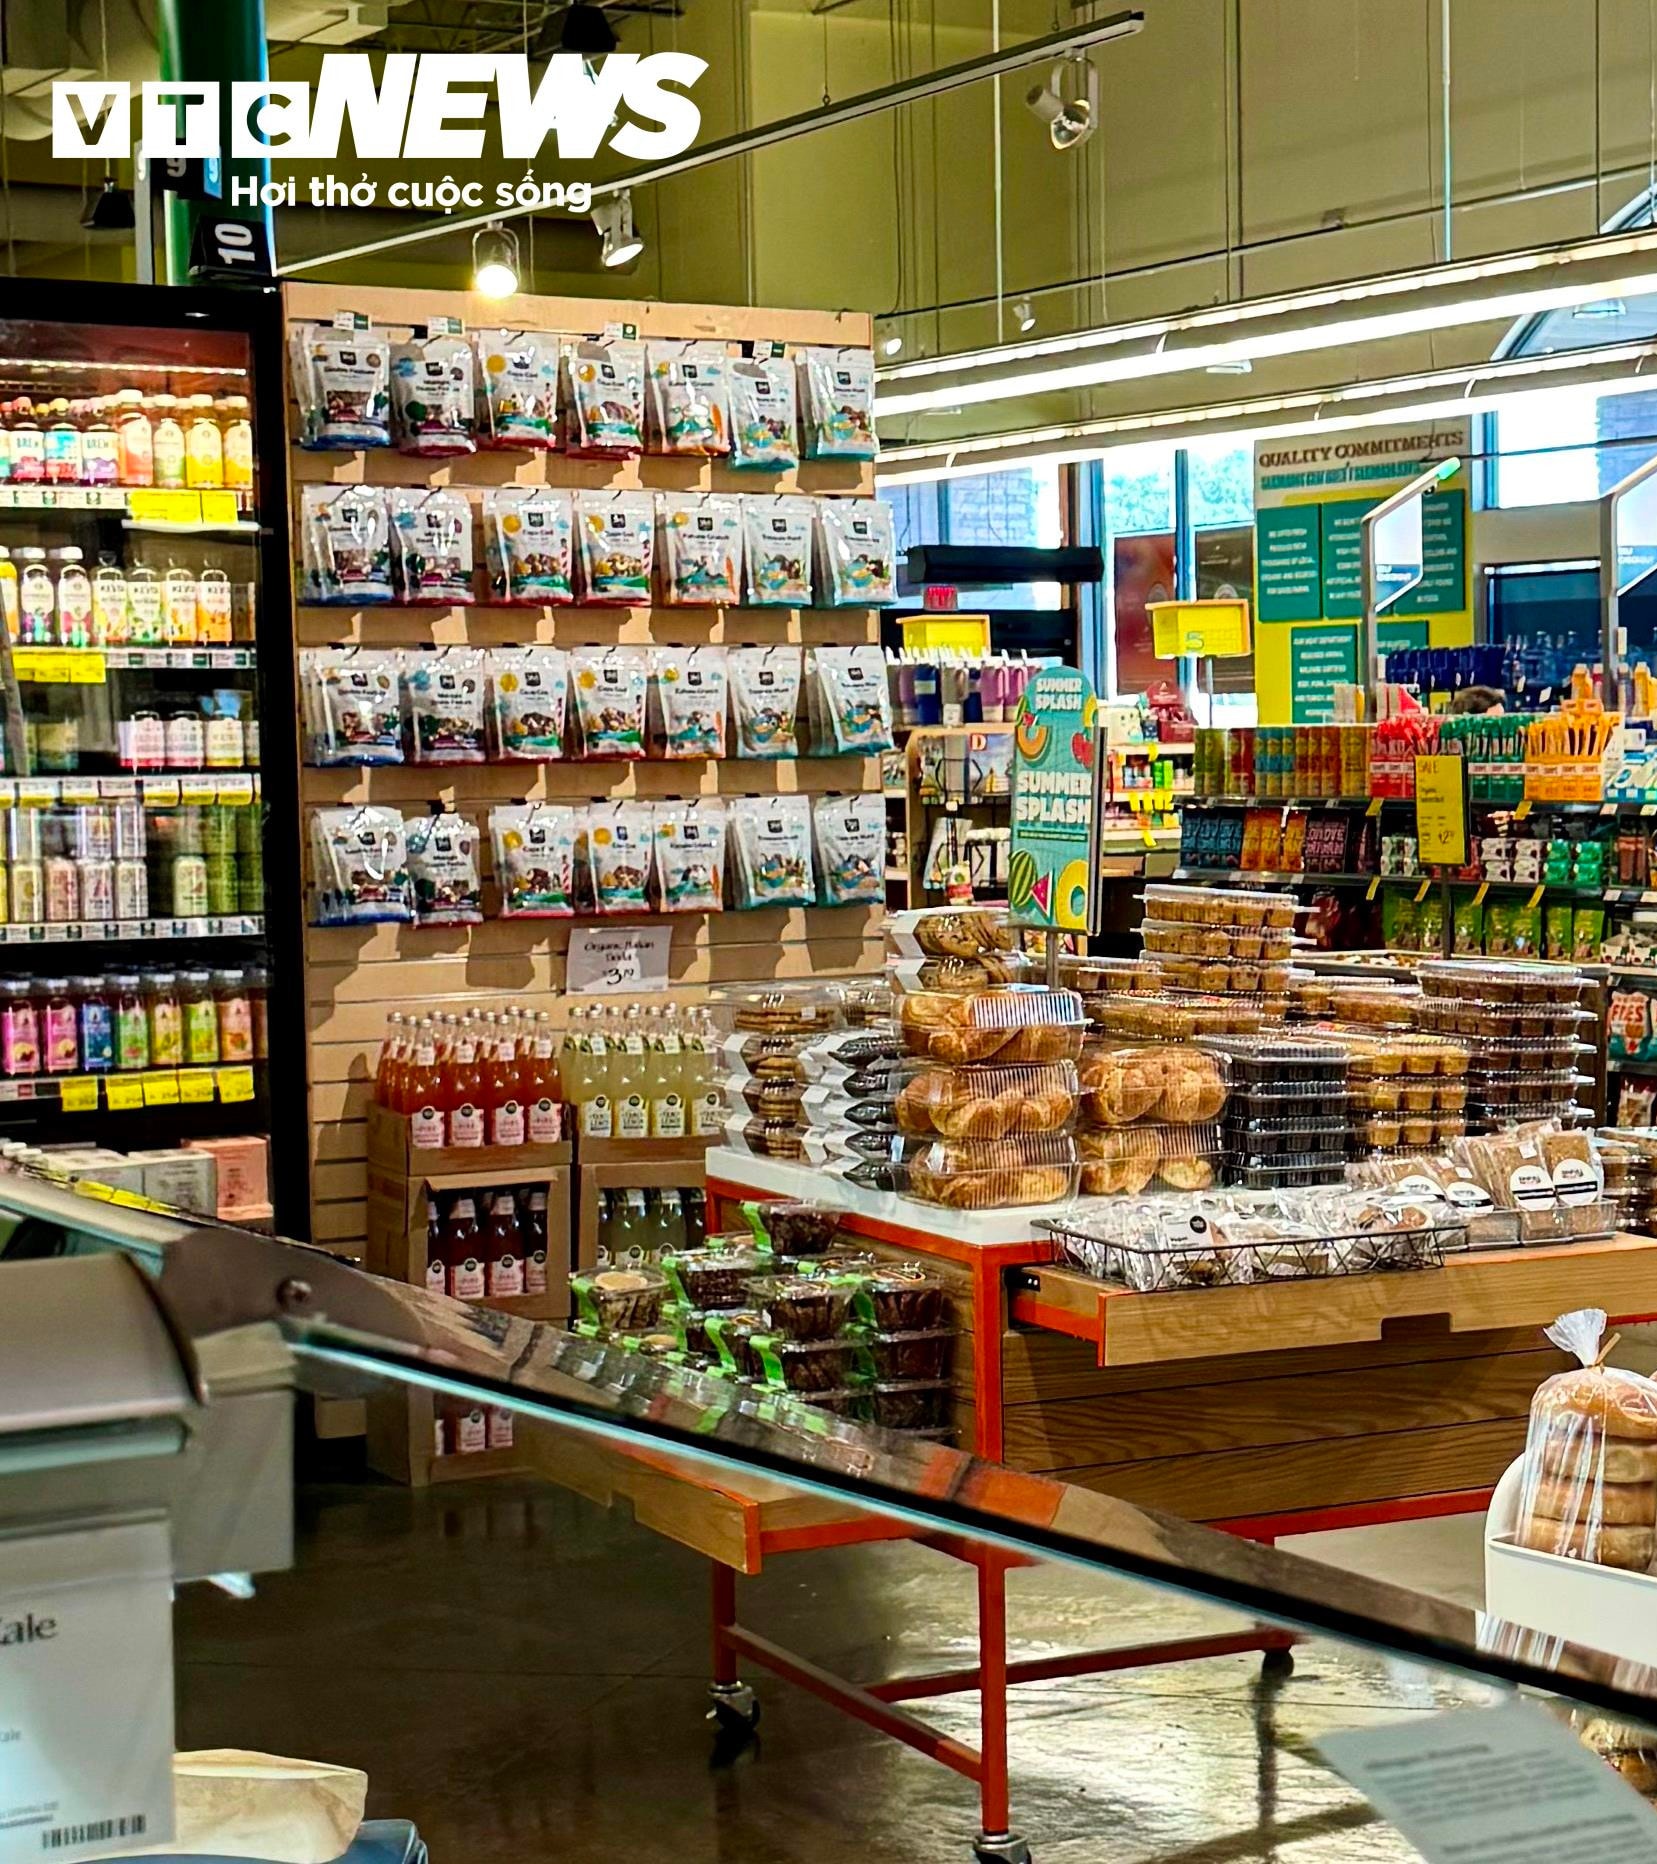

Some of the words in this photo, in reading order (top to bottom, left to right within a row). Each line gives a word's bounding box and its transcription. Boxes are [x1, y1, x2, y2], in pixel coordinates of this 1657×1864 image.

[214, 222, 256, 265] 10
[1259, 446, 1333, 468] QUALITY
[1335, 431, 1464, 459] COMMITMENTS
[1036, 678, 1082, 692] SUMMER
[1035, 694, 1082, 710] SPLASH
[1016, 770, 1092, 796] SUMMER
[1016, 796, 1092, 824] SPLASH
[0, 1613, 57, 1645] ale
